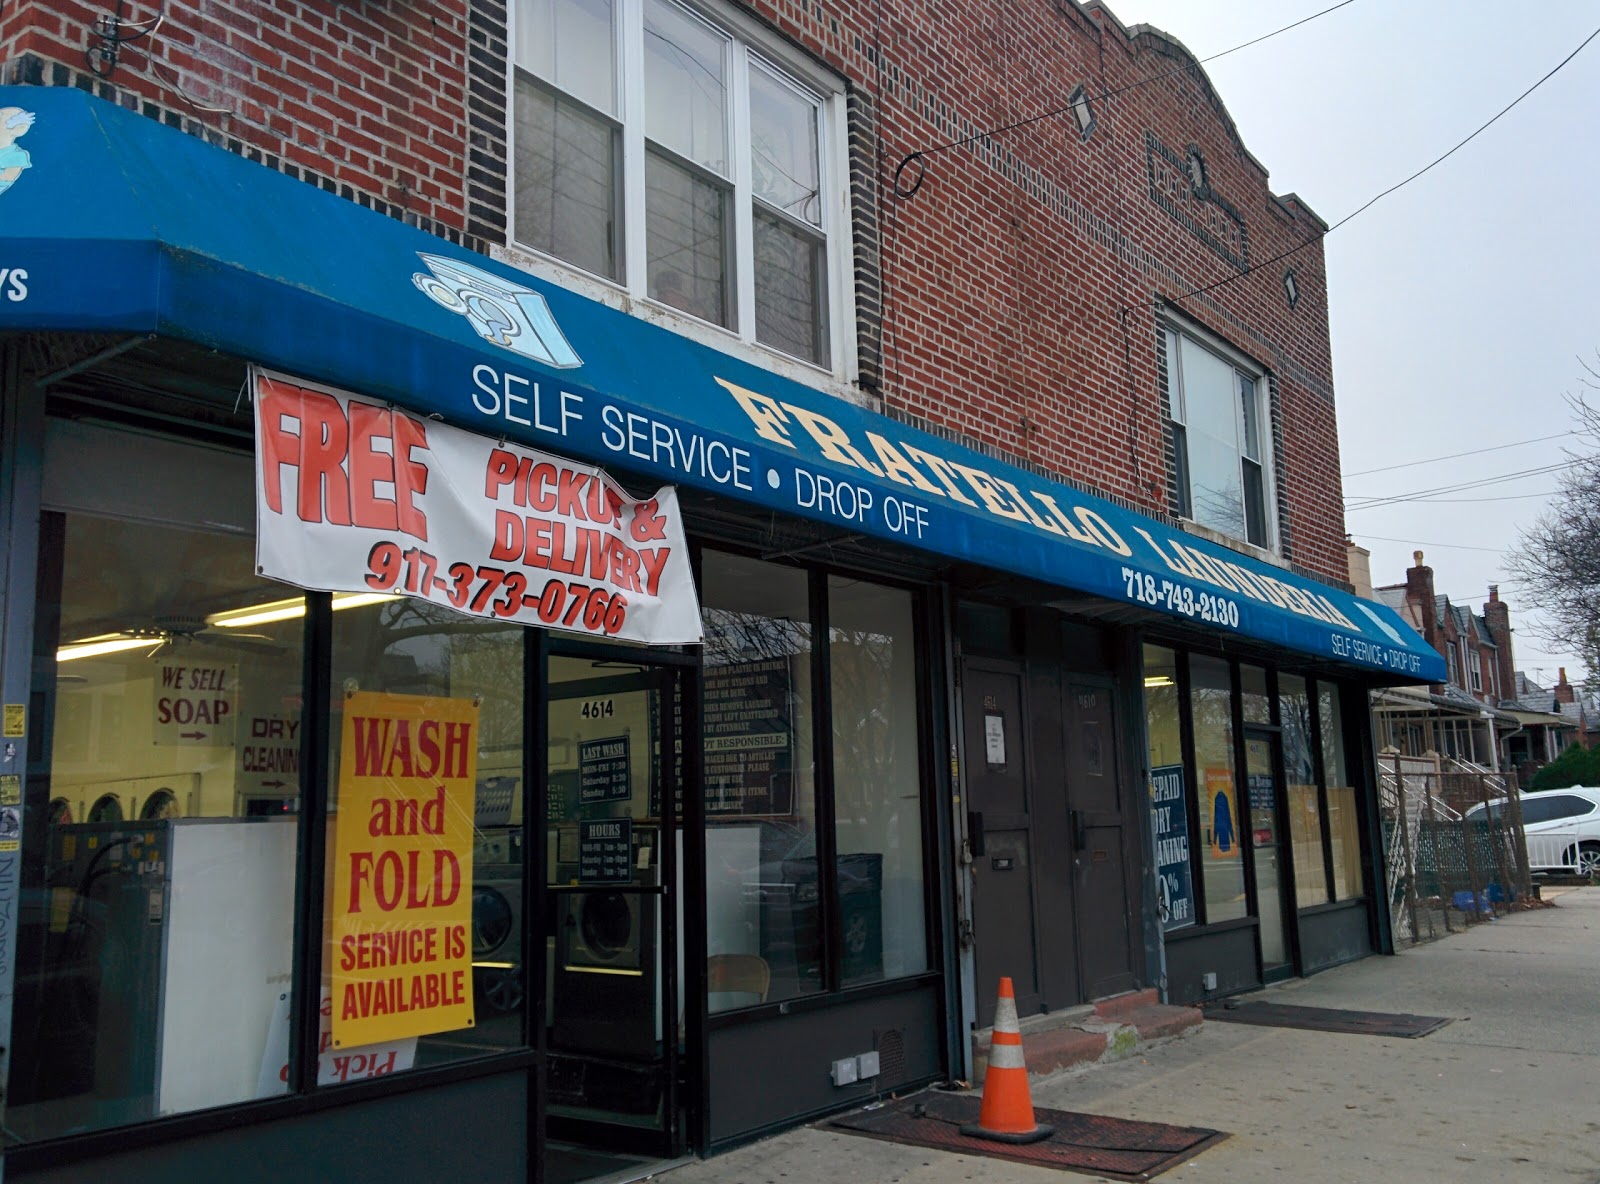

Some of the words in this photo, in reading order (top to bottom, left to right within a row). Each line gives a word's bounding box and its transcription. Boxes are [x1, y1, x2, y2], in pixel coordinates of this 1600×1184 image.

[257, 377, 430, 541] FREE
[472, 364, 583, 436] SELF
[601, 405, 753, 491] SERVICE
[796, 469, 873, 523] DROP
[884, 496, 929, 538] OFF
[630, 498, 667, 543] &
[714, 376, 1133, 557] FRATELLO
[1132, 525, 1361, 632] LAUNDERIA
[489, 508, 671, 597] DELIVERY
[364, 541, 628, 634] 917-373-0766
[1122, 567, 1239, 627] 718-743-2130
[1331, 633, 1351, 657] SELF
[1353, 639, 1382, 665] SERVICE
[1389, 650, 1408, 670] DROP
[1409, 654, 1421, 673] OFF
[162, 666, 186, 689] WE
[189, 668, 226, 691] SELL
[158, 697, 229, 724] SOAP
[252, 717, 300, 740] DRY
[582, 700, 613, 718] 4614
[243, 746, 300, 773] CLEANIN
[352, 717, 471, 778] WASH
[582, 746, 601, 759] LAST
[602, 743, 624, 757] WASH
[717, 735, 785, 748] RESPONSIBLE:
[368, 785, 446, 837] and
[589, 824, 621, 837] HOURS
[347, 849, 461, 914] FOLD
[1173, 898, 1187, 920] OFF
[340, 928, 437, 972] SERVICE
[445, 925, 465, 959] IS
[342, 970, 465, 1021] AVAILABLE
